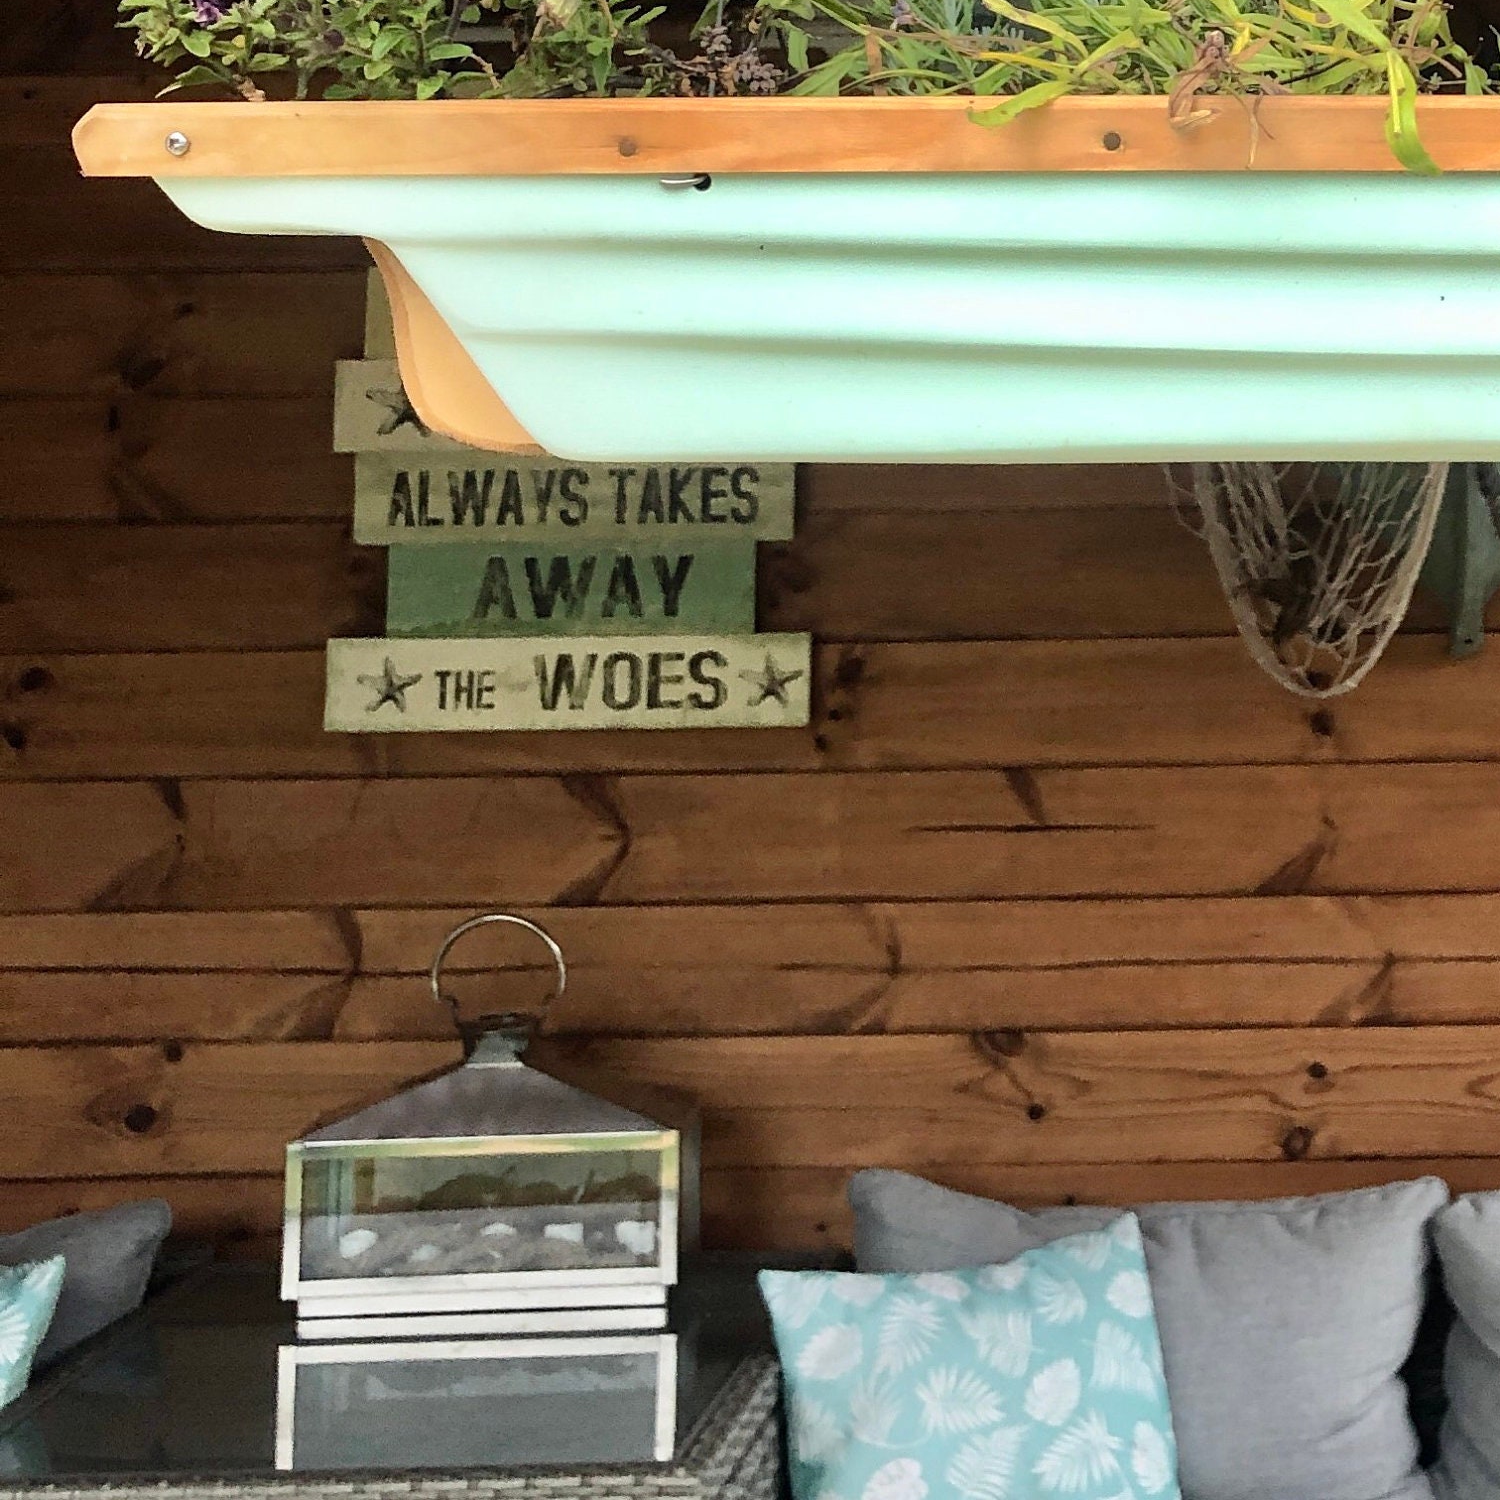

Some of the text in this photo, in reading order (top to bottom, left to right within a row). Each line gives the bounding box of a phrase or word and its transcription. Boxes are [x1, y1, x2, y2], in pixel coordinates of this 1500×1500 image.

[388, 467, 760, 527] ALWAYS TAKES
[473, 555, 694, 619] AWAY
[433, 650, 729, 711] THE WOES
